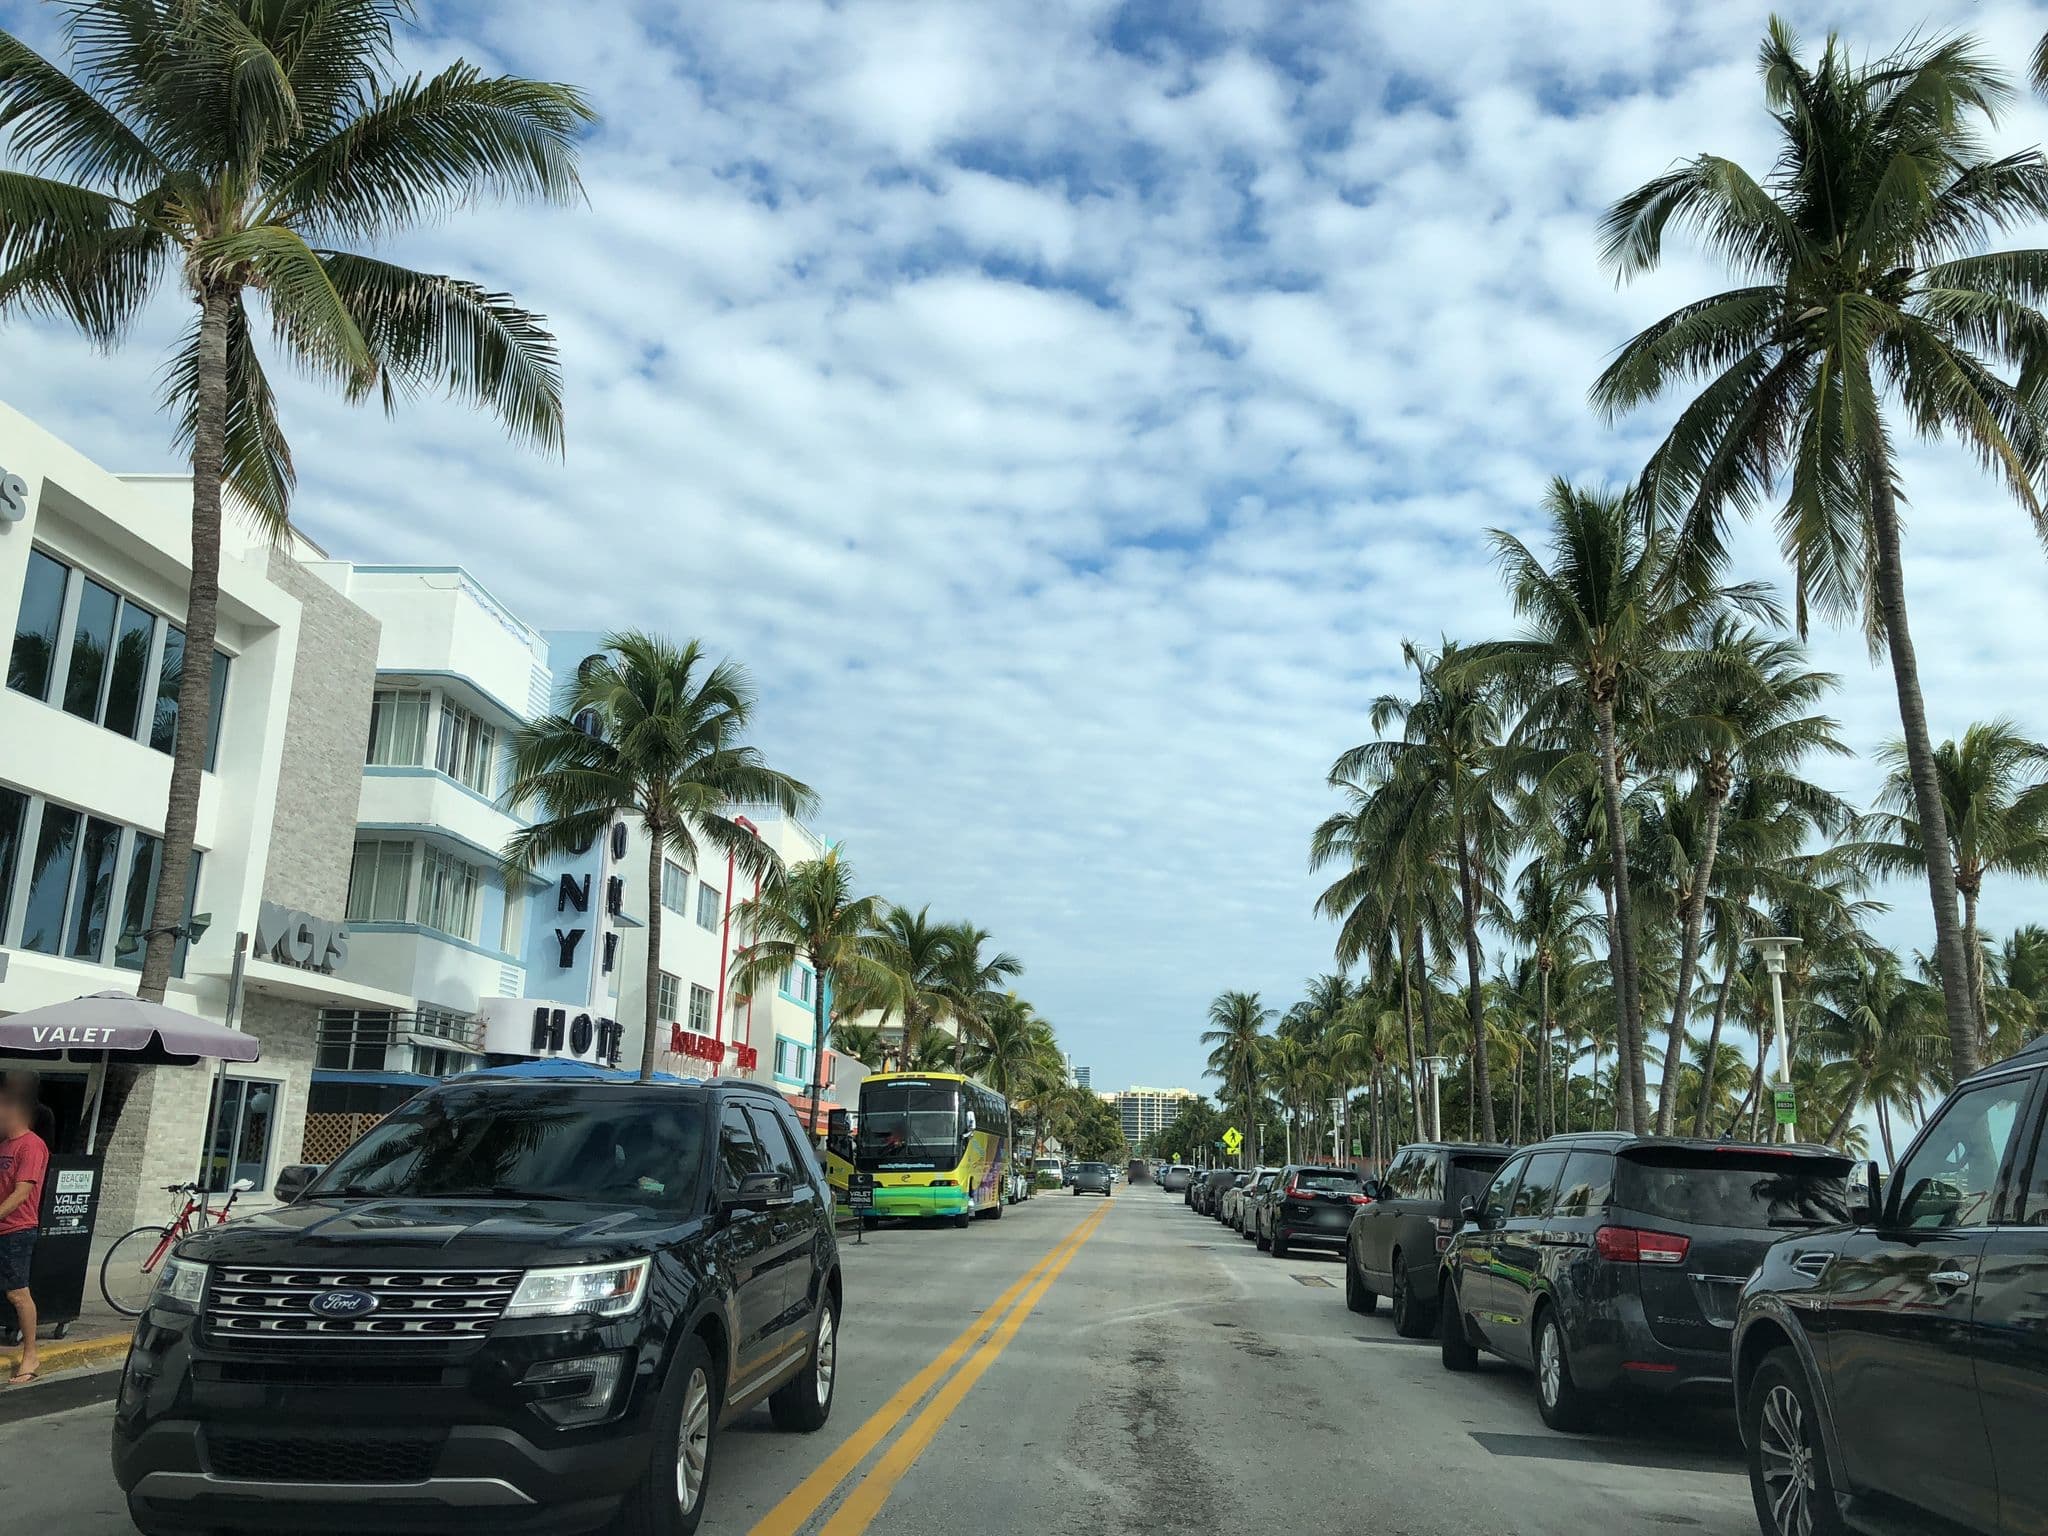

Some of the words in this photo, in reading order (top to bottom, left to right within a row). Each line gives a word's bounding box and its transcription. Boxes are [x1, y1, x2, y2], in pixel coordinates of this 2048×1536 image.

[288, 911, 350, 970] CVS
[32, 1027, 115, 1043] VALET
[60, 1173, 90, 1182] BEACON
[55, 1194, 90, 1204] VALET
[53, 1205, 88, 1214] PARKING
[322, 1294, 361, 1310] Ford
